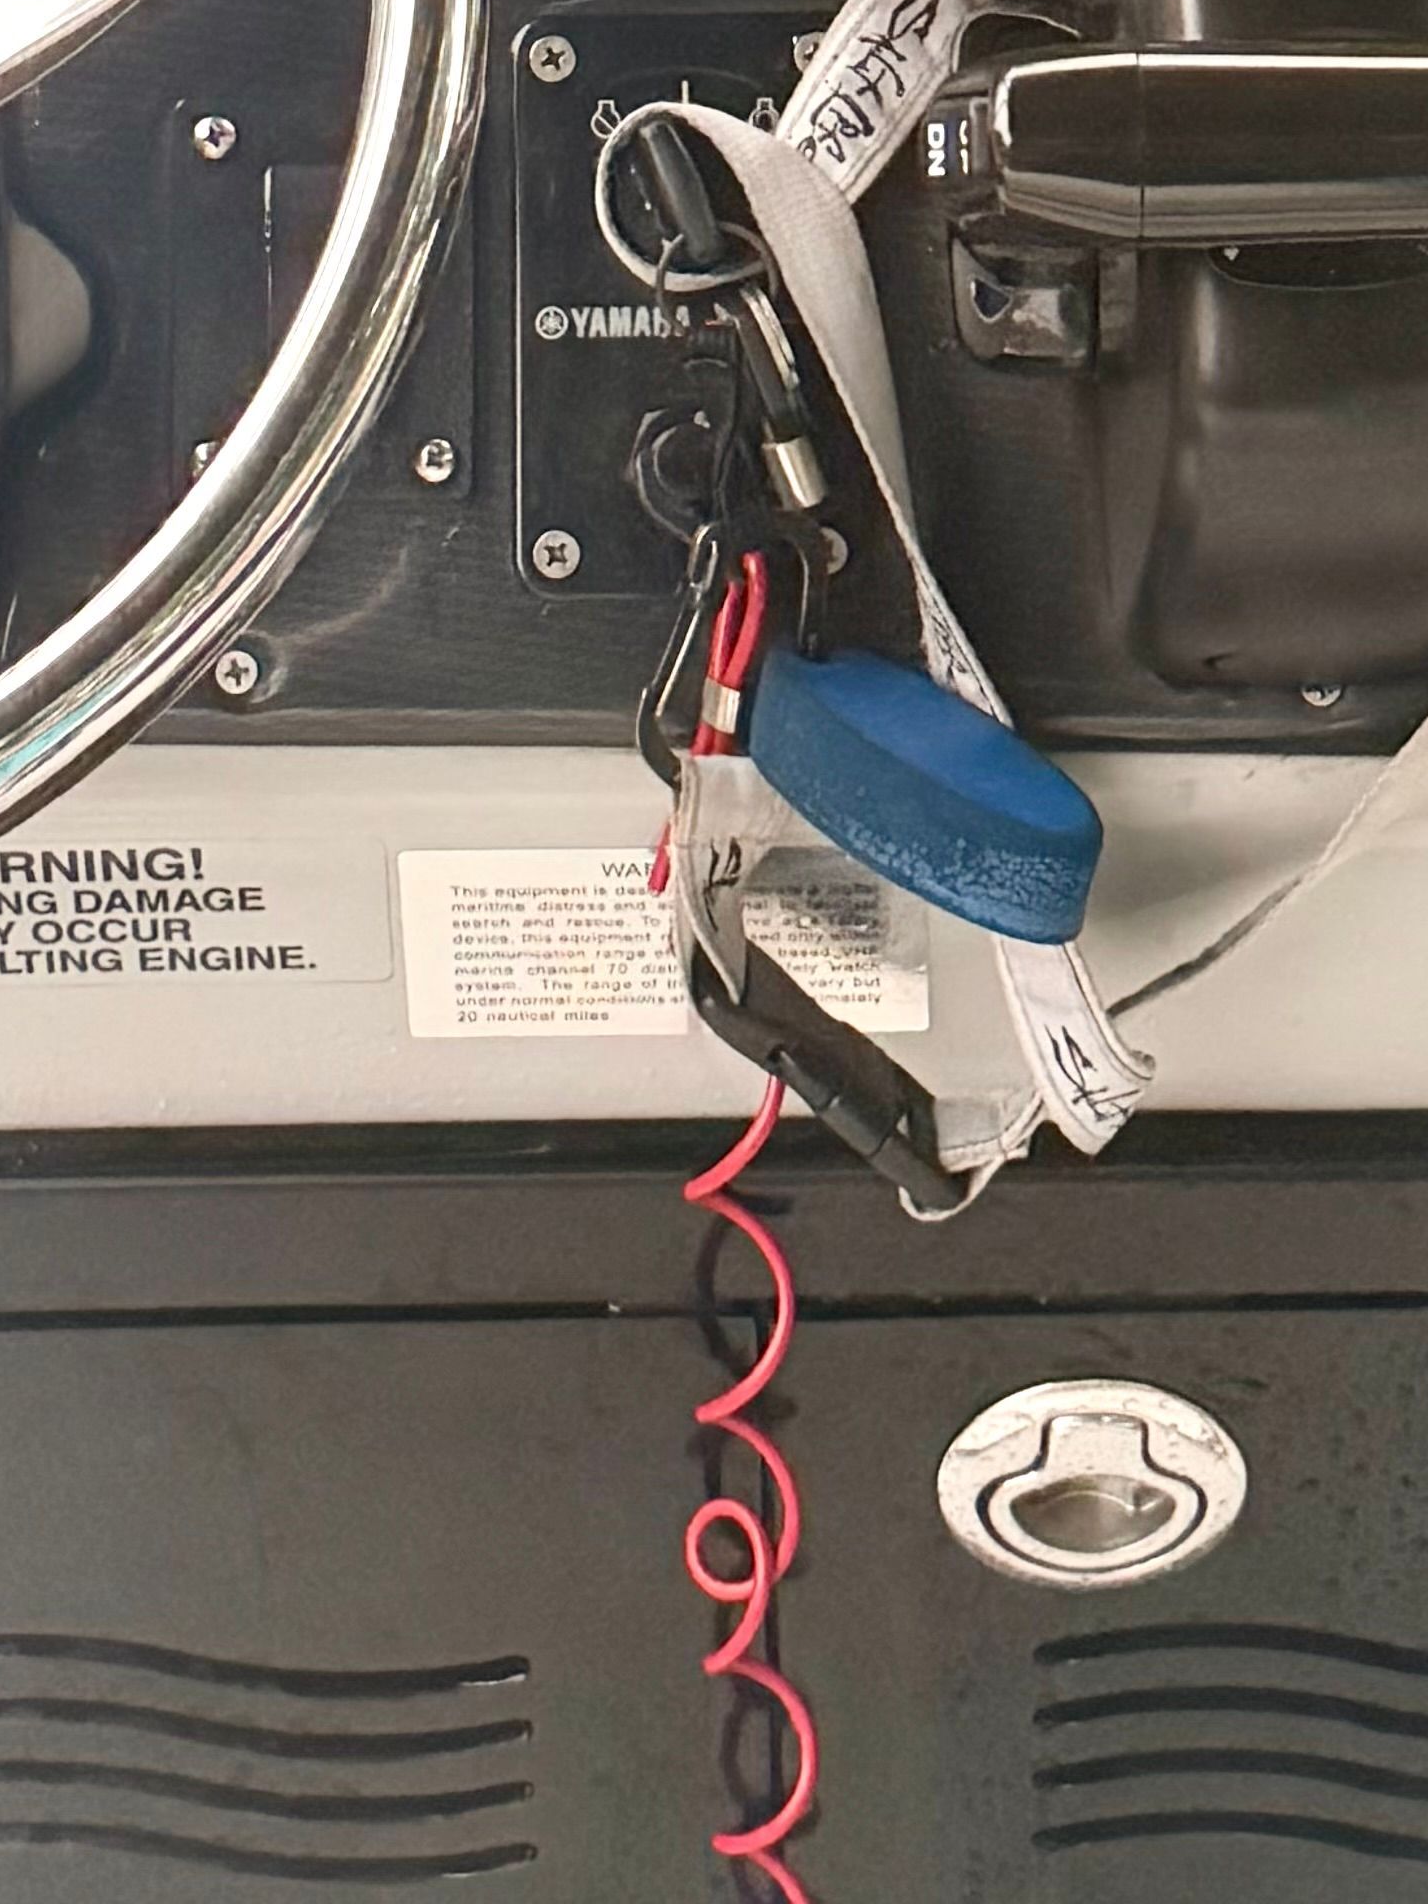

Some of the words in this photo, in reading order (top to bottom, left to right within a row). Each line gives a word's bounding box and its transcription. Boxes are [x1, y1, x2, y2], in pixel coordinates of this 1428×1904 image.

[450, 885, 488, 898] This
[495, 885, 588, 899] equipment
[73, 887, 266, 915] DAMAGE
[451, 902, 525, 912] maritime
[537, 901, 605, 911] distress
[613, 901, 647, 911] and
[452, 917, 510, 929] search
[522, 917, 555, 928] and
[643, 915, 660, 928] To
[32, 918, 193, 944] OCCUR
[522, 932, 552, 944] this
[559, 932, 651, 945] equipment
[139, 944, 318, 973] ENGINE.
[596, 949, 646, 961] range
[455, 965, 514, 976] marine
[527, 964, 595, 976] channel
[609, 964, 628, 975] 70
[541, 979, 573, 990] The
[584, 980, 632, 992] range
[456, 995, 504, 1007] under
[511, 995, 571, 1006] normal
[458, 1011, 478, 1023] 20
[486, 1010, 556, 1022] nautical
[564, 1010, 609, 1022] miles
